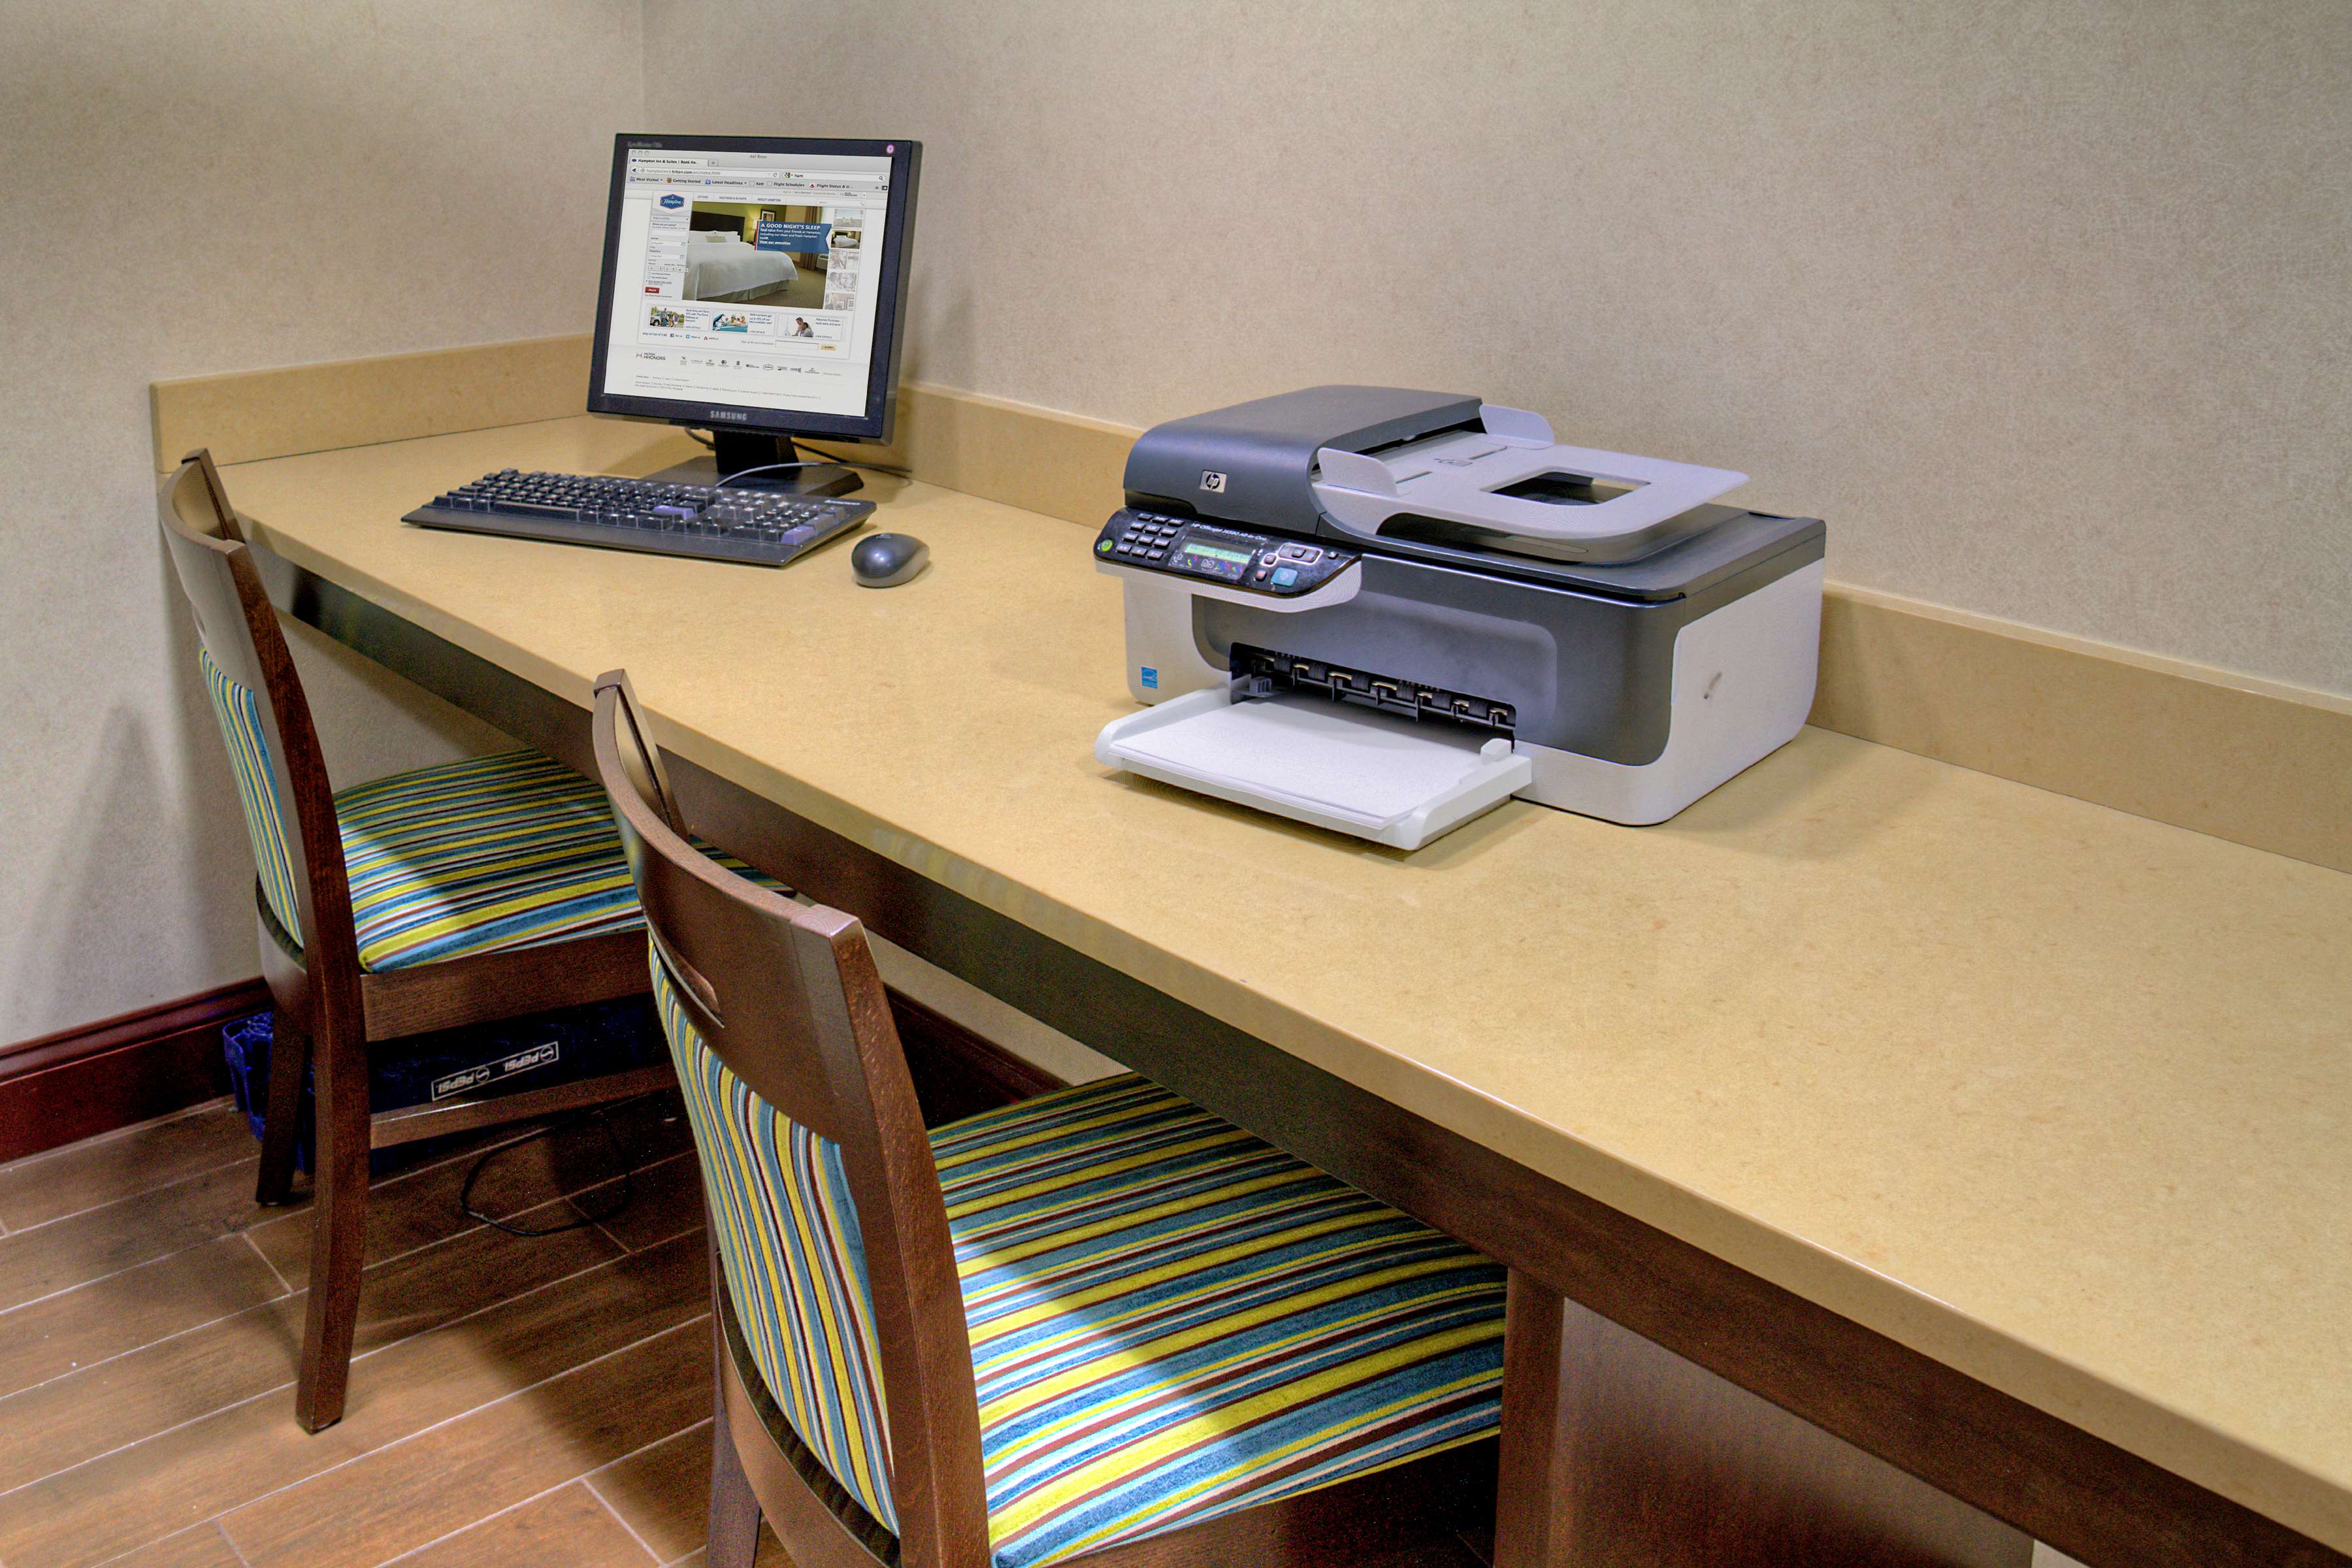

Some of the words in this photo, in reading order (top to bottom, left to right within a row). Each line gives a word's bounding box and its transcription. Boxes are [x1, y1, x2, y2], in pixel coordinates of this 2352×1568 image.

[710, 410, 747, 421] SAMSUNG
[1239, 532, 1267, 541] All-in-One
[503, 1053, 539, 1071] PEPSI
[437, 1073, 474, 1094] PEPSI
